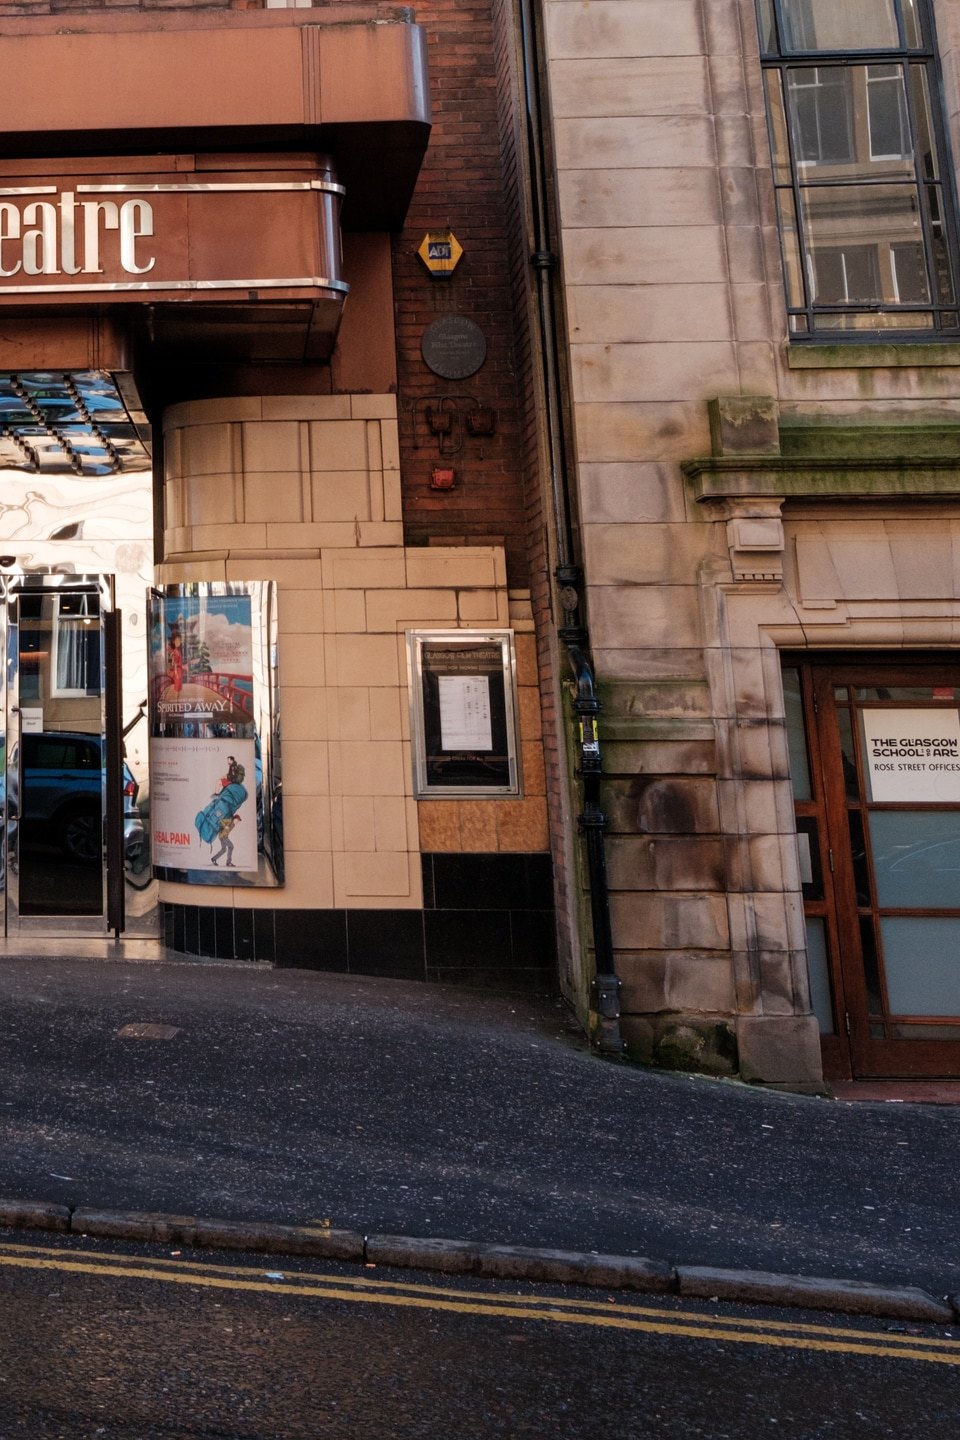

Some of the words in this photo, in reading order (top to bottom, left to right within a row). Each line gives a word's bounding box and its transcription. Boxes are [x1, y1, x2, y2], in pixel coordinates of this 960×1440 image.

[429, 245, 451, 257] ADT
[157, 702, 191, 713] SPIRITED
[194, 699, 227, 712] AWAY
[871, 739, 897, 747] THE
[900, 739, 958, 747] GLASGOW
[872, 749, 924, 757] SCHOOL
[874, 763, 895, 771] ROSE
[898, 763, 926, 771] STREET
[929, 763, 960, 771] OFFICES
[170, 832, 190, 845] PAIN
